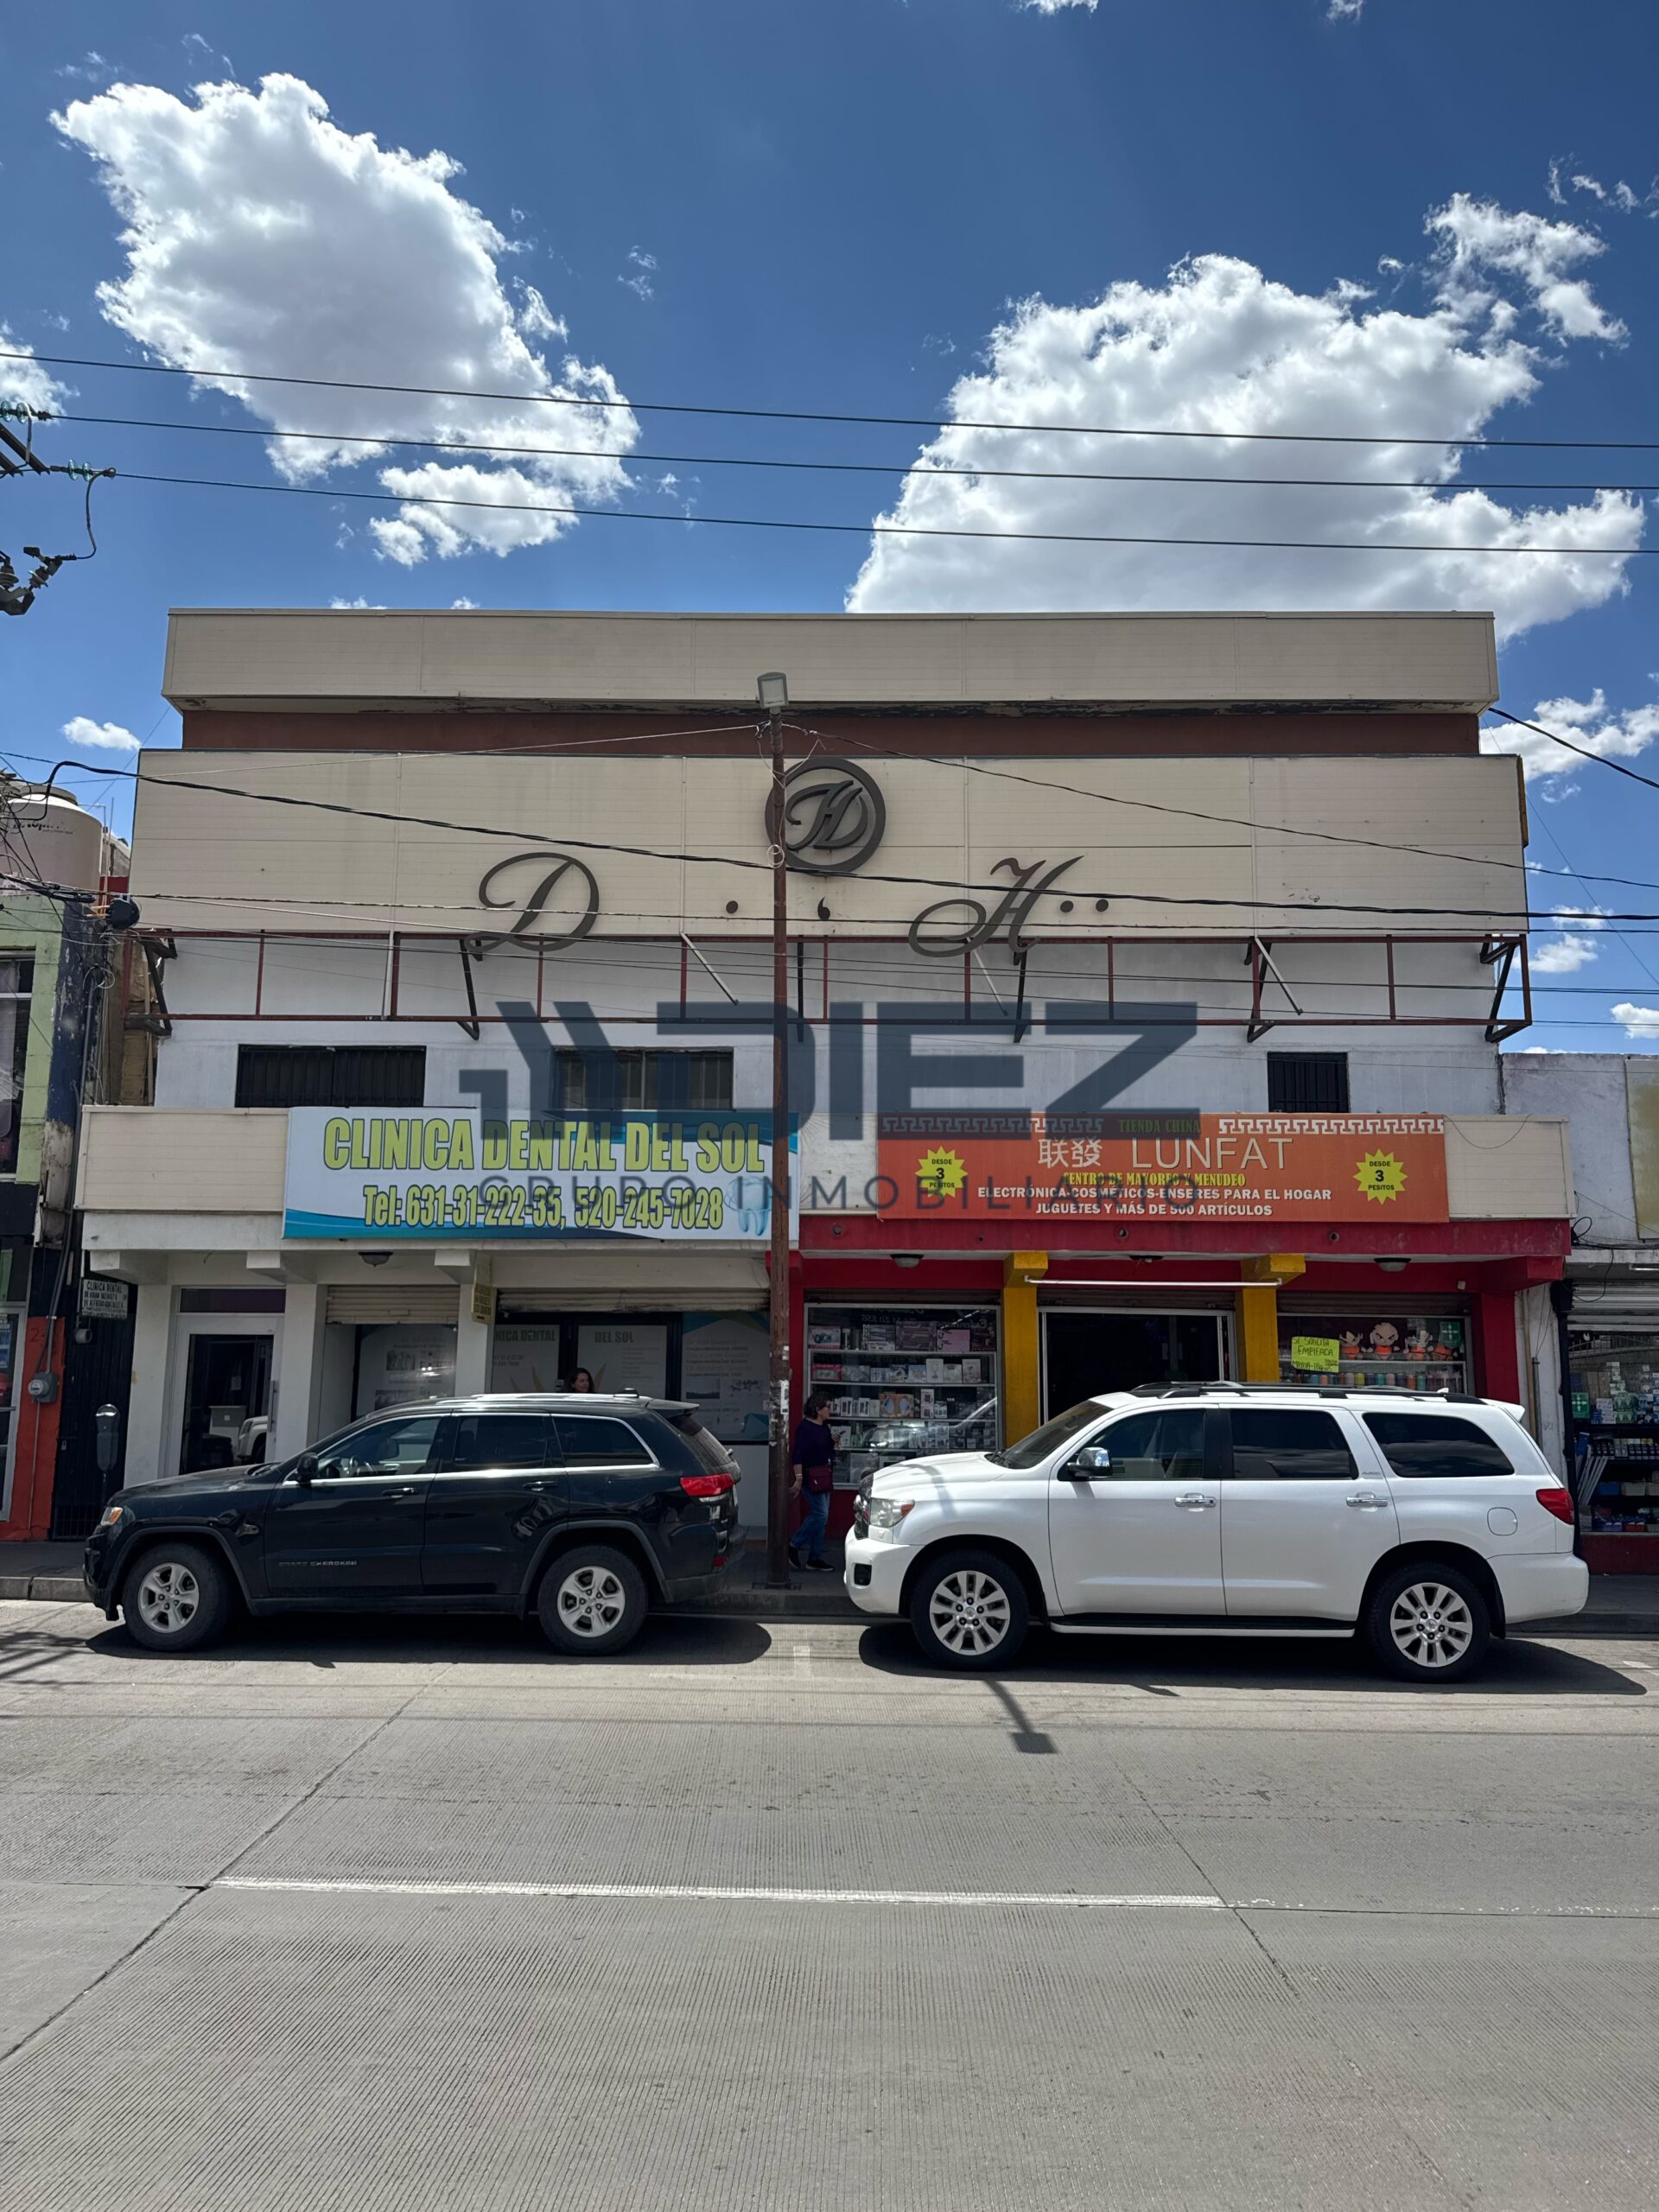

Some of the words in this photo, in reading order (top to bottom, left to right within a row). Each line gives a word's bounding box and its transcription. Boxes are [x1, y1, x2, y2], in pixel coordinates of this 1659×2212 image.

[1120, 1120, 1161, 1134] TIENDA
[1166, 1120, 1202, 1135] CHINA
[323, 1116, 474, 1171] CLINICA
[481, 1119, 617, 1173] DENTAL
[624, 1122, 690, 1173] DEL
[696, 1122, 766, 1174] SOL
[1132, 1136, 1294, 1170] LUNFAT
[935, 1168, 945, 1179] 3
[1064, 1173, 1106, 1185] CENTRO
[1109, 1173, 1124, 1185] DE
[1126, 1173, 1180, 1186] MAYOREO
[1183, 1173, 1191, 1186] Y
[1194, 1173, 1246, 1186] MENUDEO
[1375, 1170, 1384, 1182] 3
[1224, 1189, 1260, 1200] PARA
[1264, 1189, 1281, 1200] EL
[1284, 1189, 1332, 1201] HOGAR
[363, 1185, 403, 1227] Tel:
[575, 1186, 725, 1230] 520-245-7028
[1036, 1203, 1101, 1214] JUGUETES
[1103, 1204, 1113, 1214] Y
[1116, 1201, 1145, 1215] MÁS
[1149, 1205, 1166, 1215] DE
[1170, 1205, 1194, 1216] 500
[1198, 1202, 1273, 1216] ARTÍCULOS
[521, 1330, 556, 1341] DENTAL
[594, 1332, 613, 1343] DEL
[614, 1331, 634, 1343] SOL
